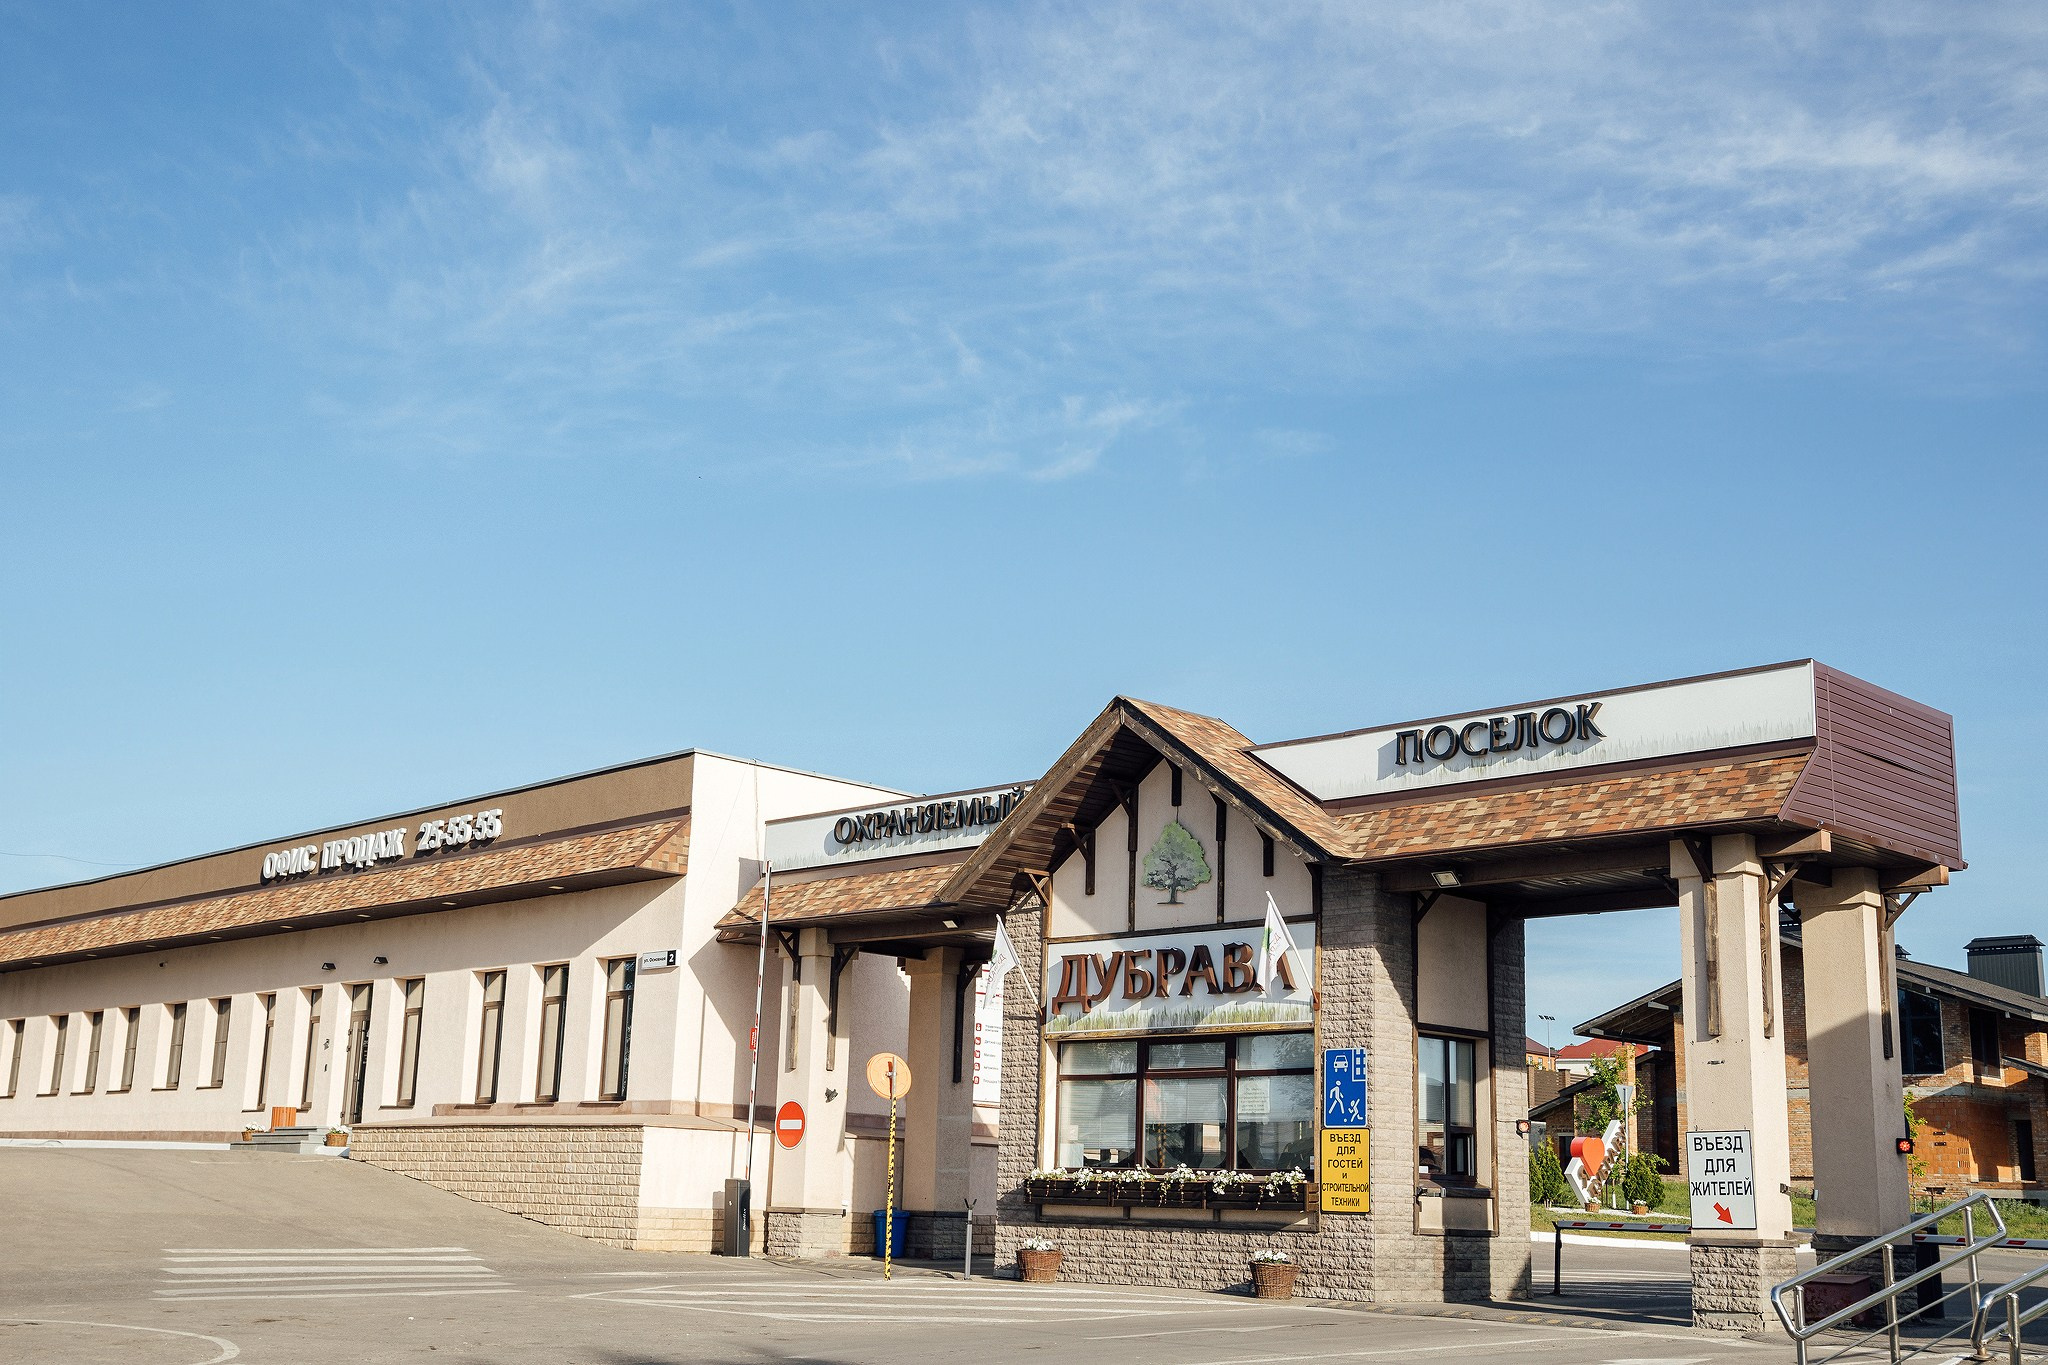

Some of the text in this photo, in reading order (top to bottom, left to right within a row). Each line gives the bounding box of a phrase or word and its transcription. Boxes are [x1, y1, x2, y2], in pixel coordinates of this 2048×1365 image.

[1395, 702, 1607, 766] ПОСЕЛОК
[833, 785, 1030, 845] ОХРАНЯЕМЫЙ
[262, 808, 504, 880] ОФИС ПРОДАЖ 25-55-55
[669, 953, 675, 963] 2
[1329, 1133, 1361, 1144] ВЪЕЗД
[1693, 1135, 1744, 1154] ВЪЕЗД
[1336, 1146, 1356, 1156] ДЛЯ
[1327, 1158, 1363, 1169] ГОСТЕЙ
[1704, 1158, 1736, 1176] ДЛЯ
[1322, 1182, 1369, 1193] СТРОИТЕЛЬНОЙ
[1690, 1176, 1753, 1196] ЖИТЕЛЕЙ
[1331, 1196, 1360, 1207] ТЕХНИКИ
